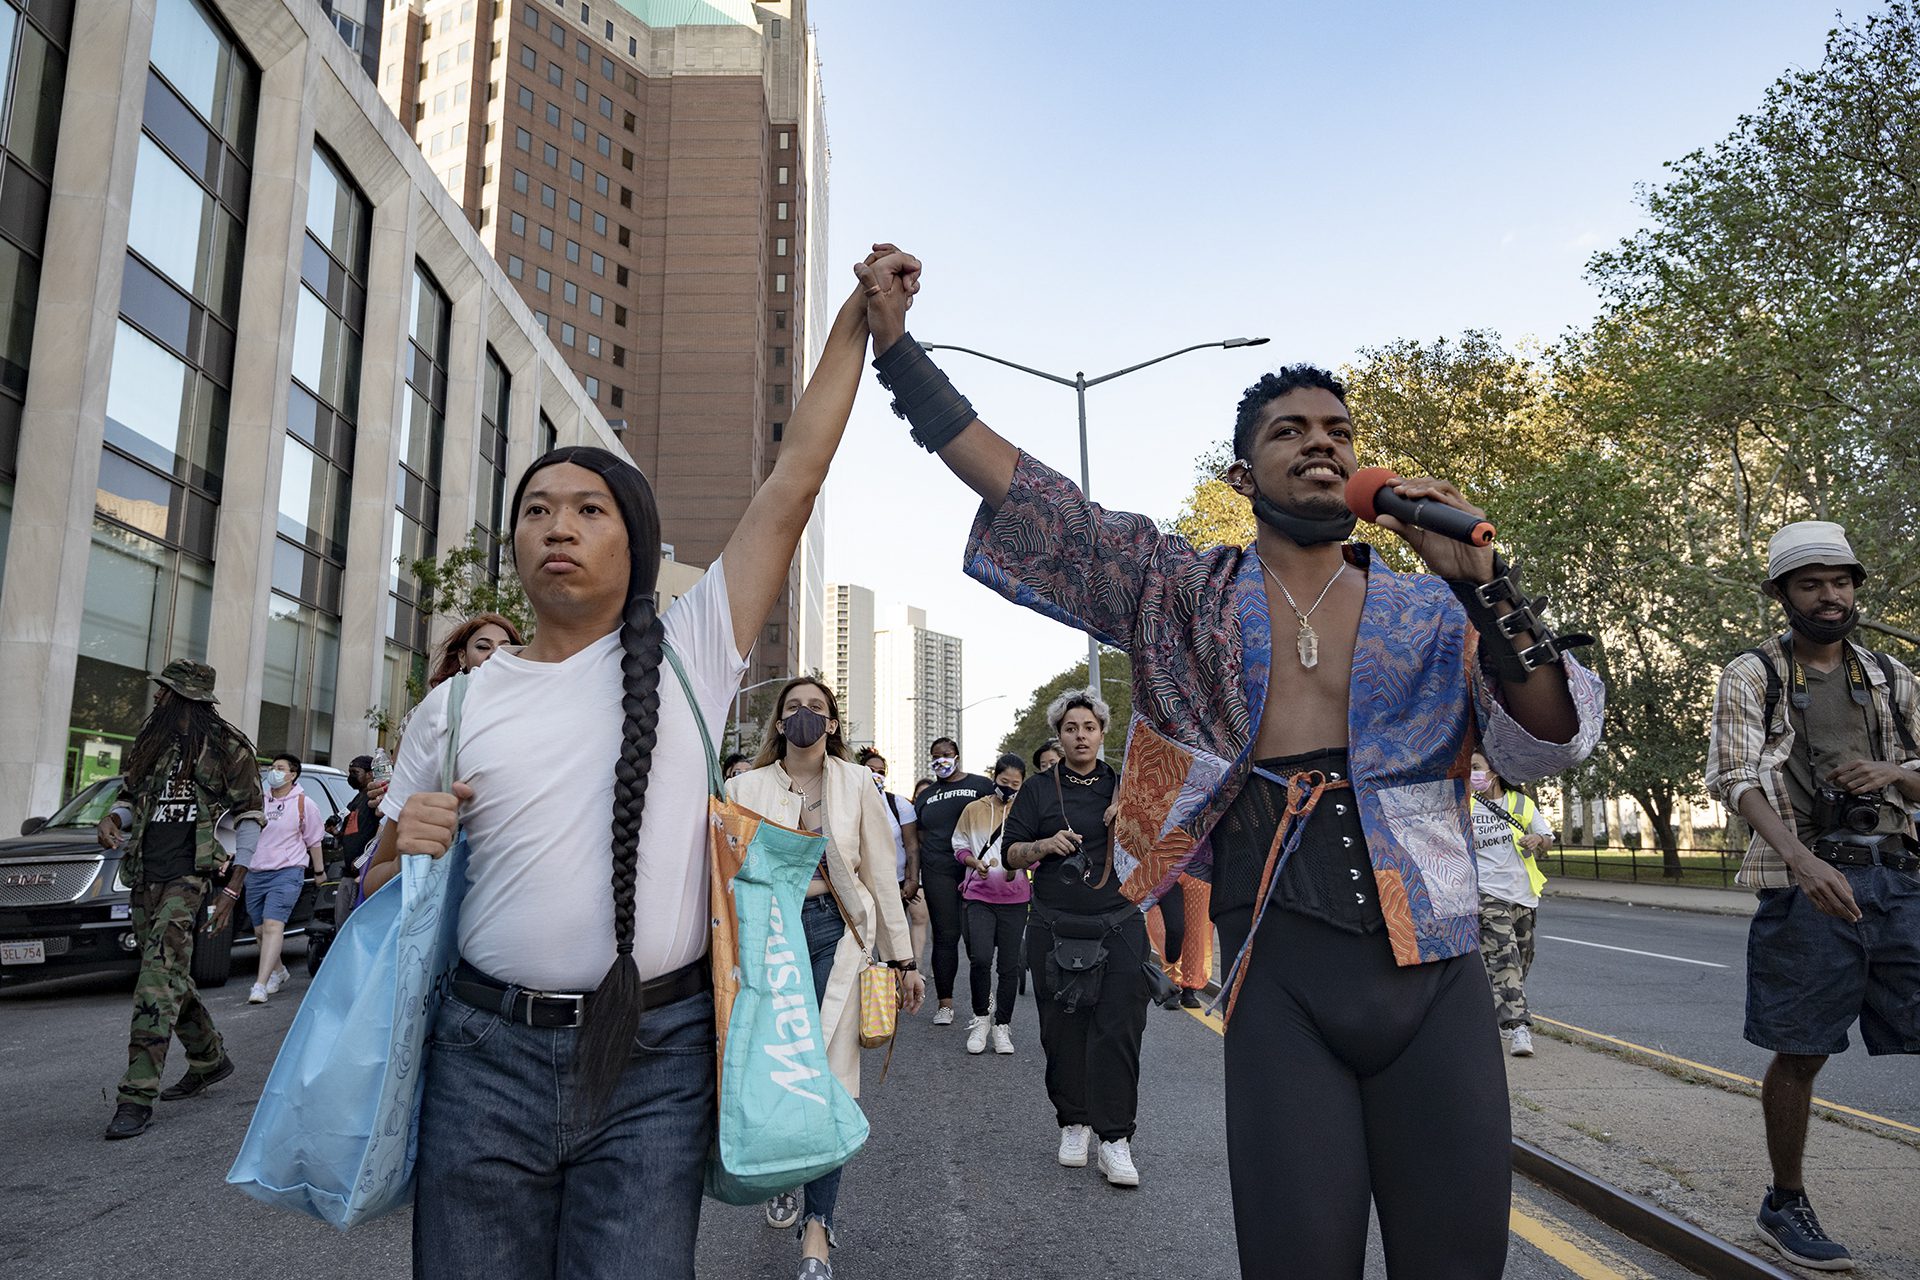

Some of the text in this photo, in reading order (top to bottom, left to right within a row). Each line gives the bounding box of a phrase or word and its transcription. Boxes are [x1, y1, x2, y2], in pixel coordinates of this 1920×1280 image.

[1849, 660, 1862, 683] Nikon
[944, 789, 977, 799] DIFFERENT
[1478, 822, 1511, 835] SUPPOR
[6, 873, 57, 886] GMC
[3, 948, 41, 960] 3EL 754
